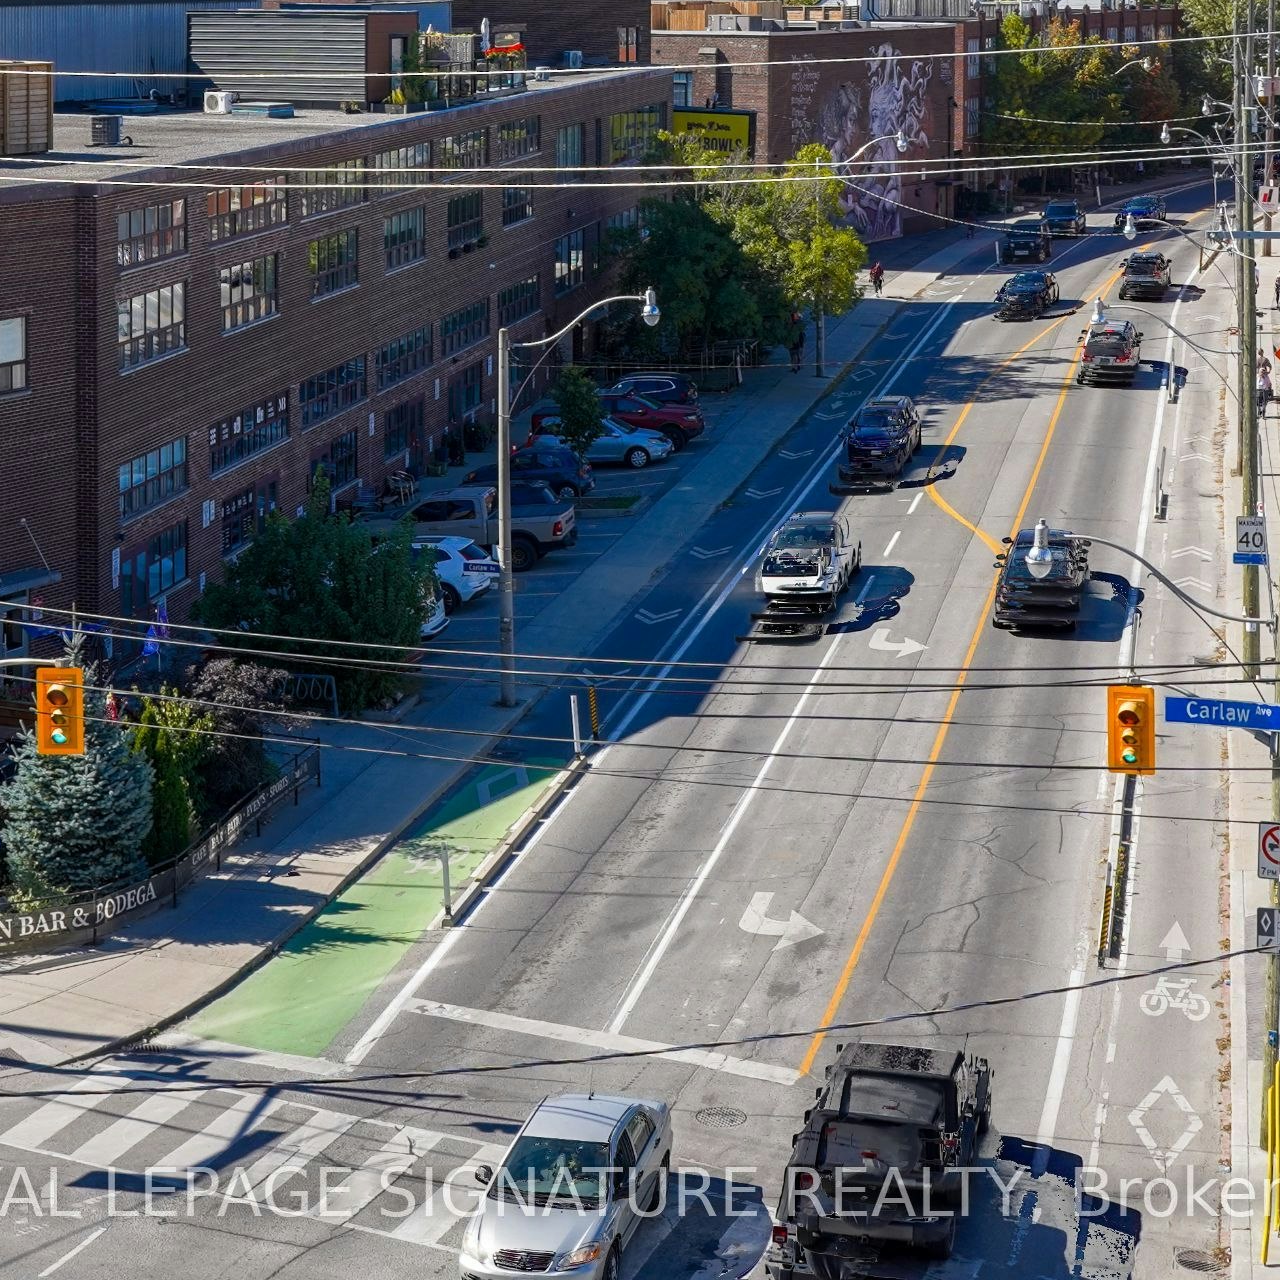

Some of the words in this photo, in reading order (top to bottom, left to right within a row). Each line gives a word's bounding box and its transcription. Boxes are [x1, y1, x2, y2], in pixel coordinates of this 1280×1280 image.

[1238, 531, 1264, 548] 40
[1186, 700, 1250, 723] Carlaw
[1255, 706, 1272, 717] Ave
[1261, 867, 1266, 875] 7
[19, 911, 67, 938] BAR
[72, 907, 90, 927] &
[96, 881, 158, 924] BODEGA
